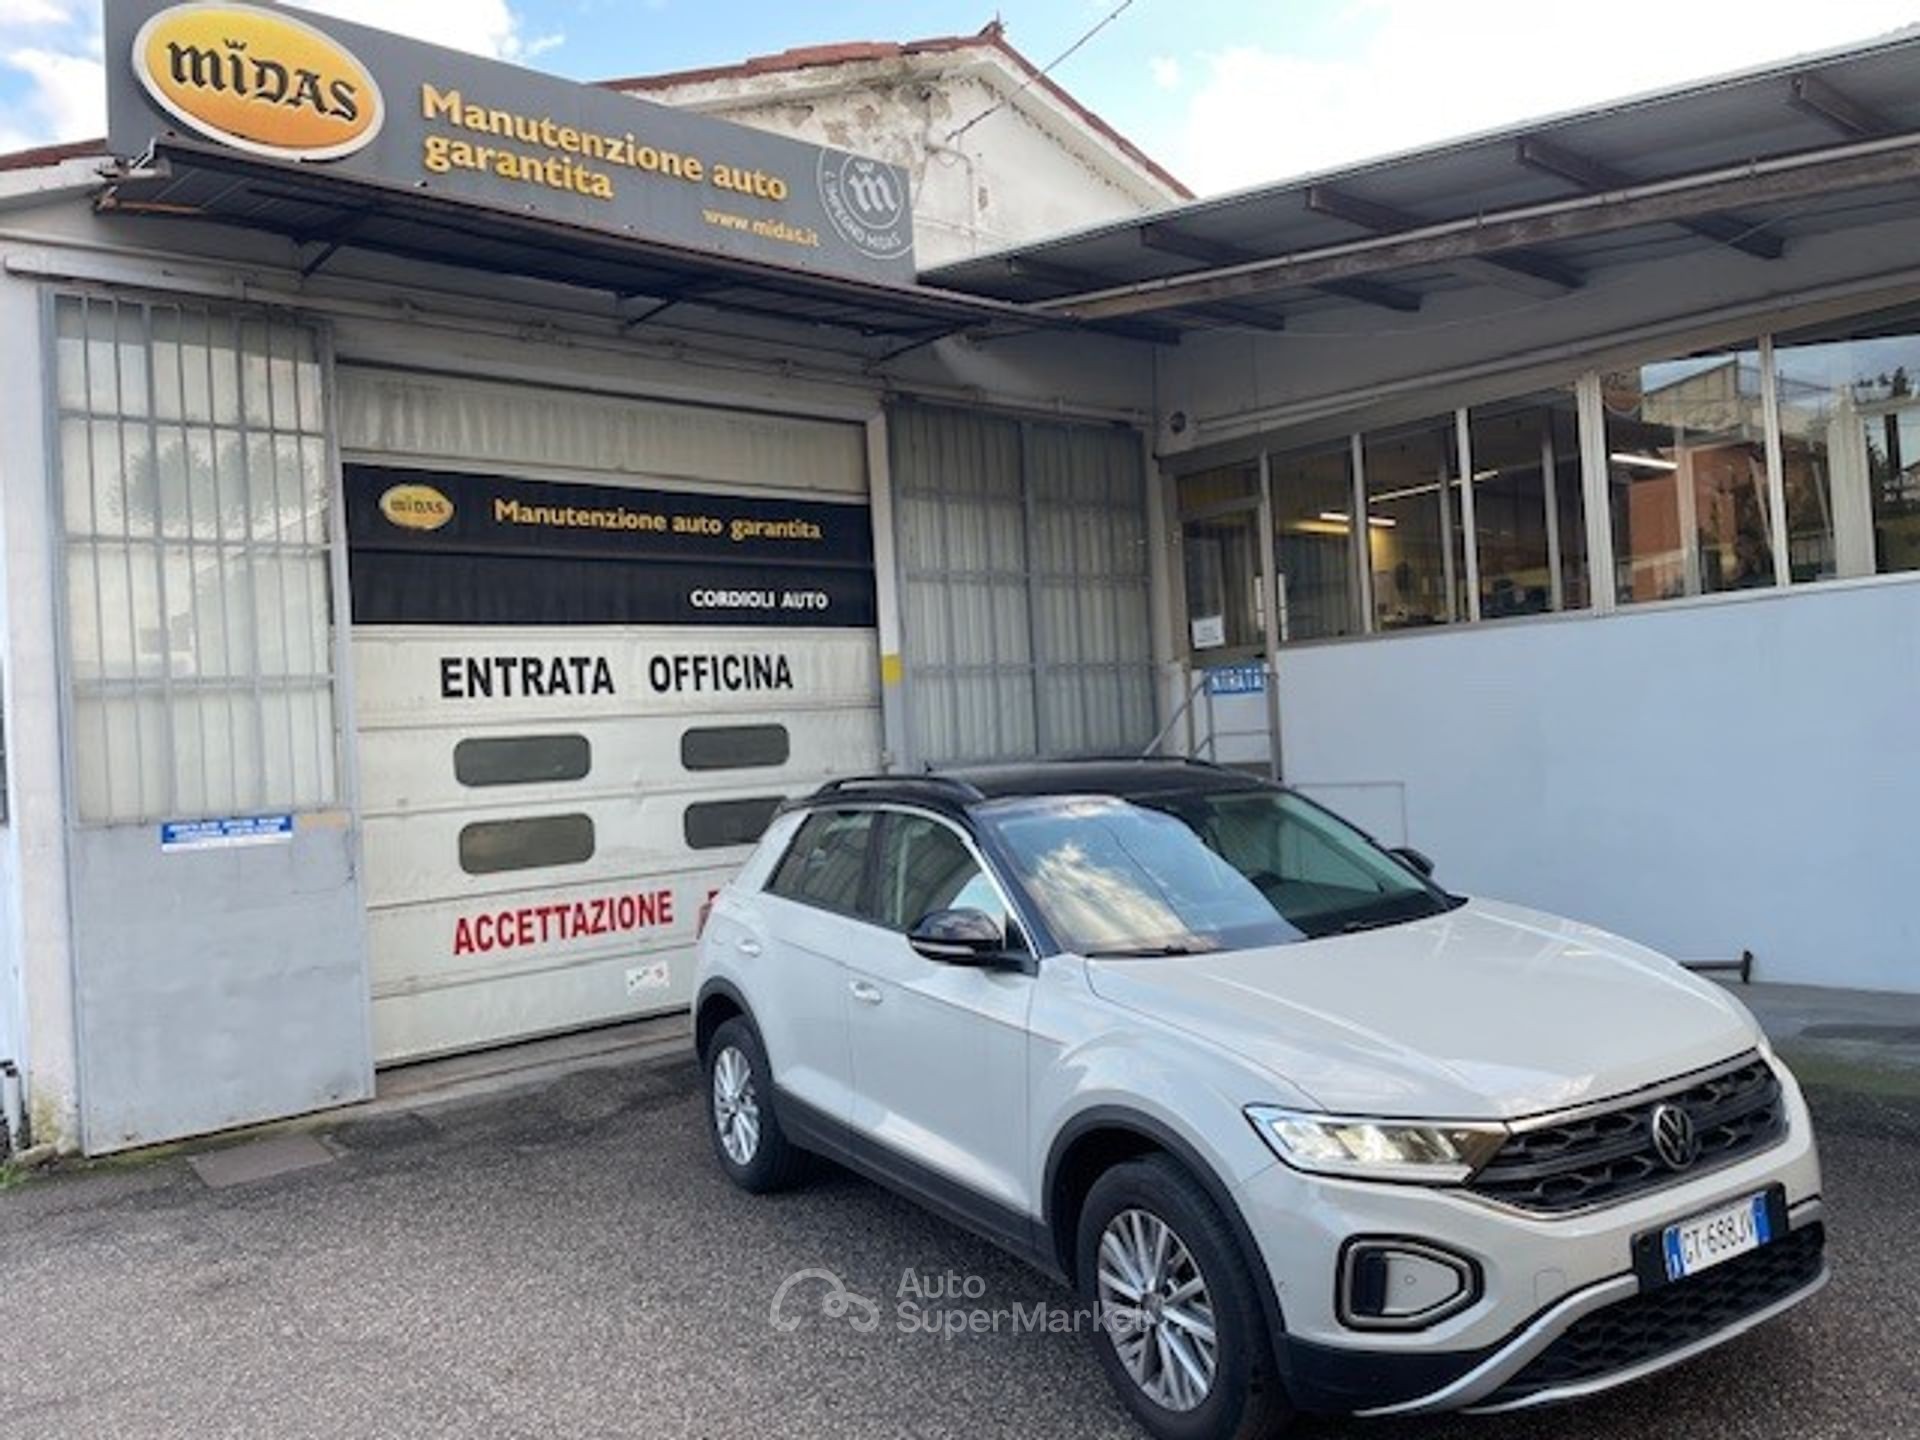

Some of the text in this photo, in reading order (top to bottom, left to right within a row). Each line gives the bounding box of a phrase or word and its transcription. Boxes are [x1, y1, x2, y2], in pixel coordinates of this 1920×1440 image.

[420, 83, 788, 202] Manutenzione auto
[424, 133, 613, 199] garantita
[494, 498, 822, 542] Manutenzione auto garantita
[691, 588, 829, 609] CORDIOLI AUTO
[440, 653, 794, 698] ENTRATA OFFICINA
[453, 890, 674, 956] ACCETTAZIONE
